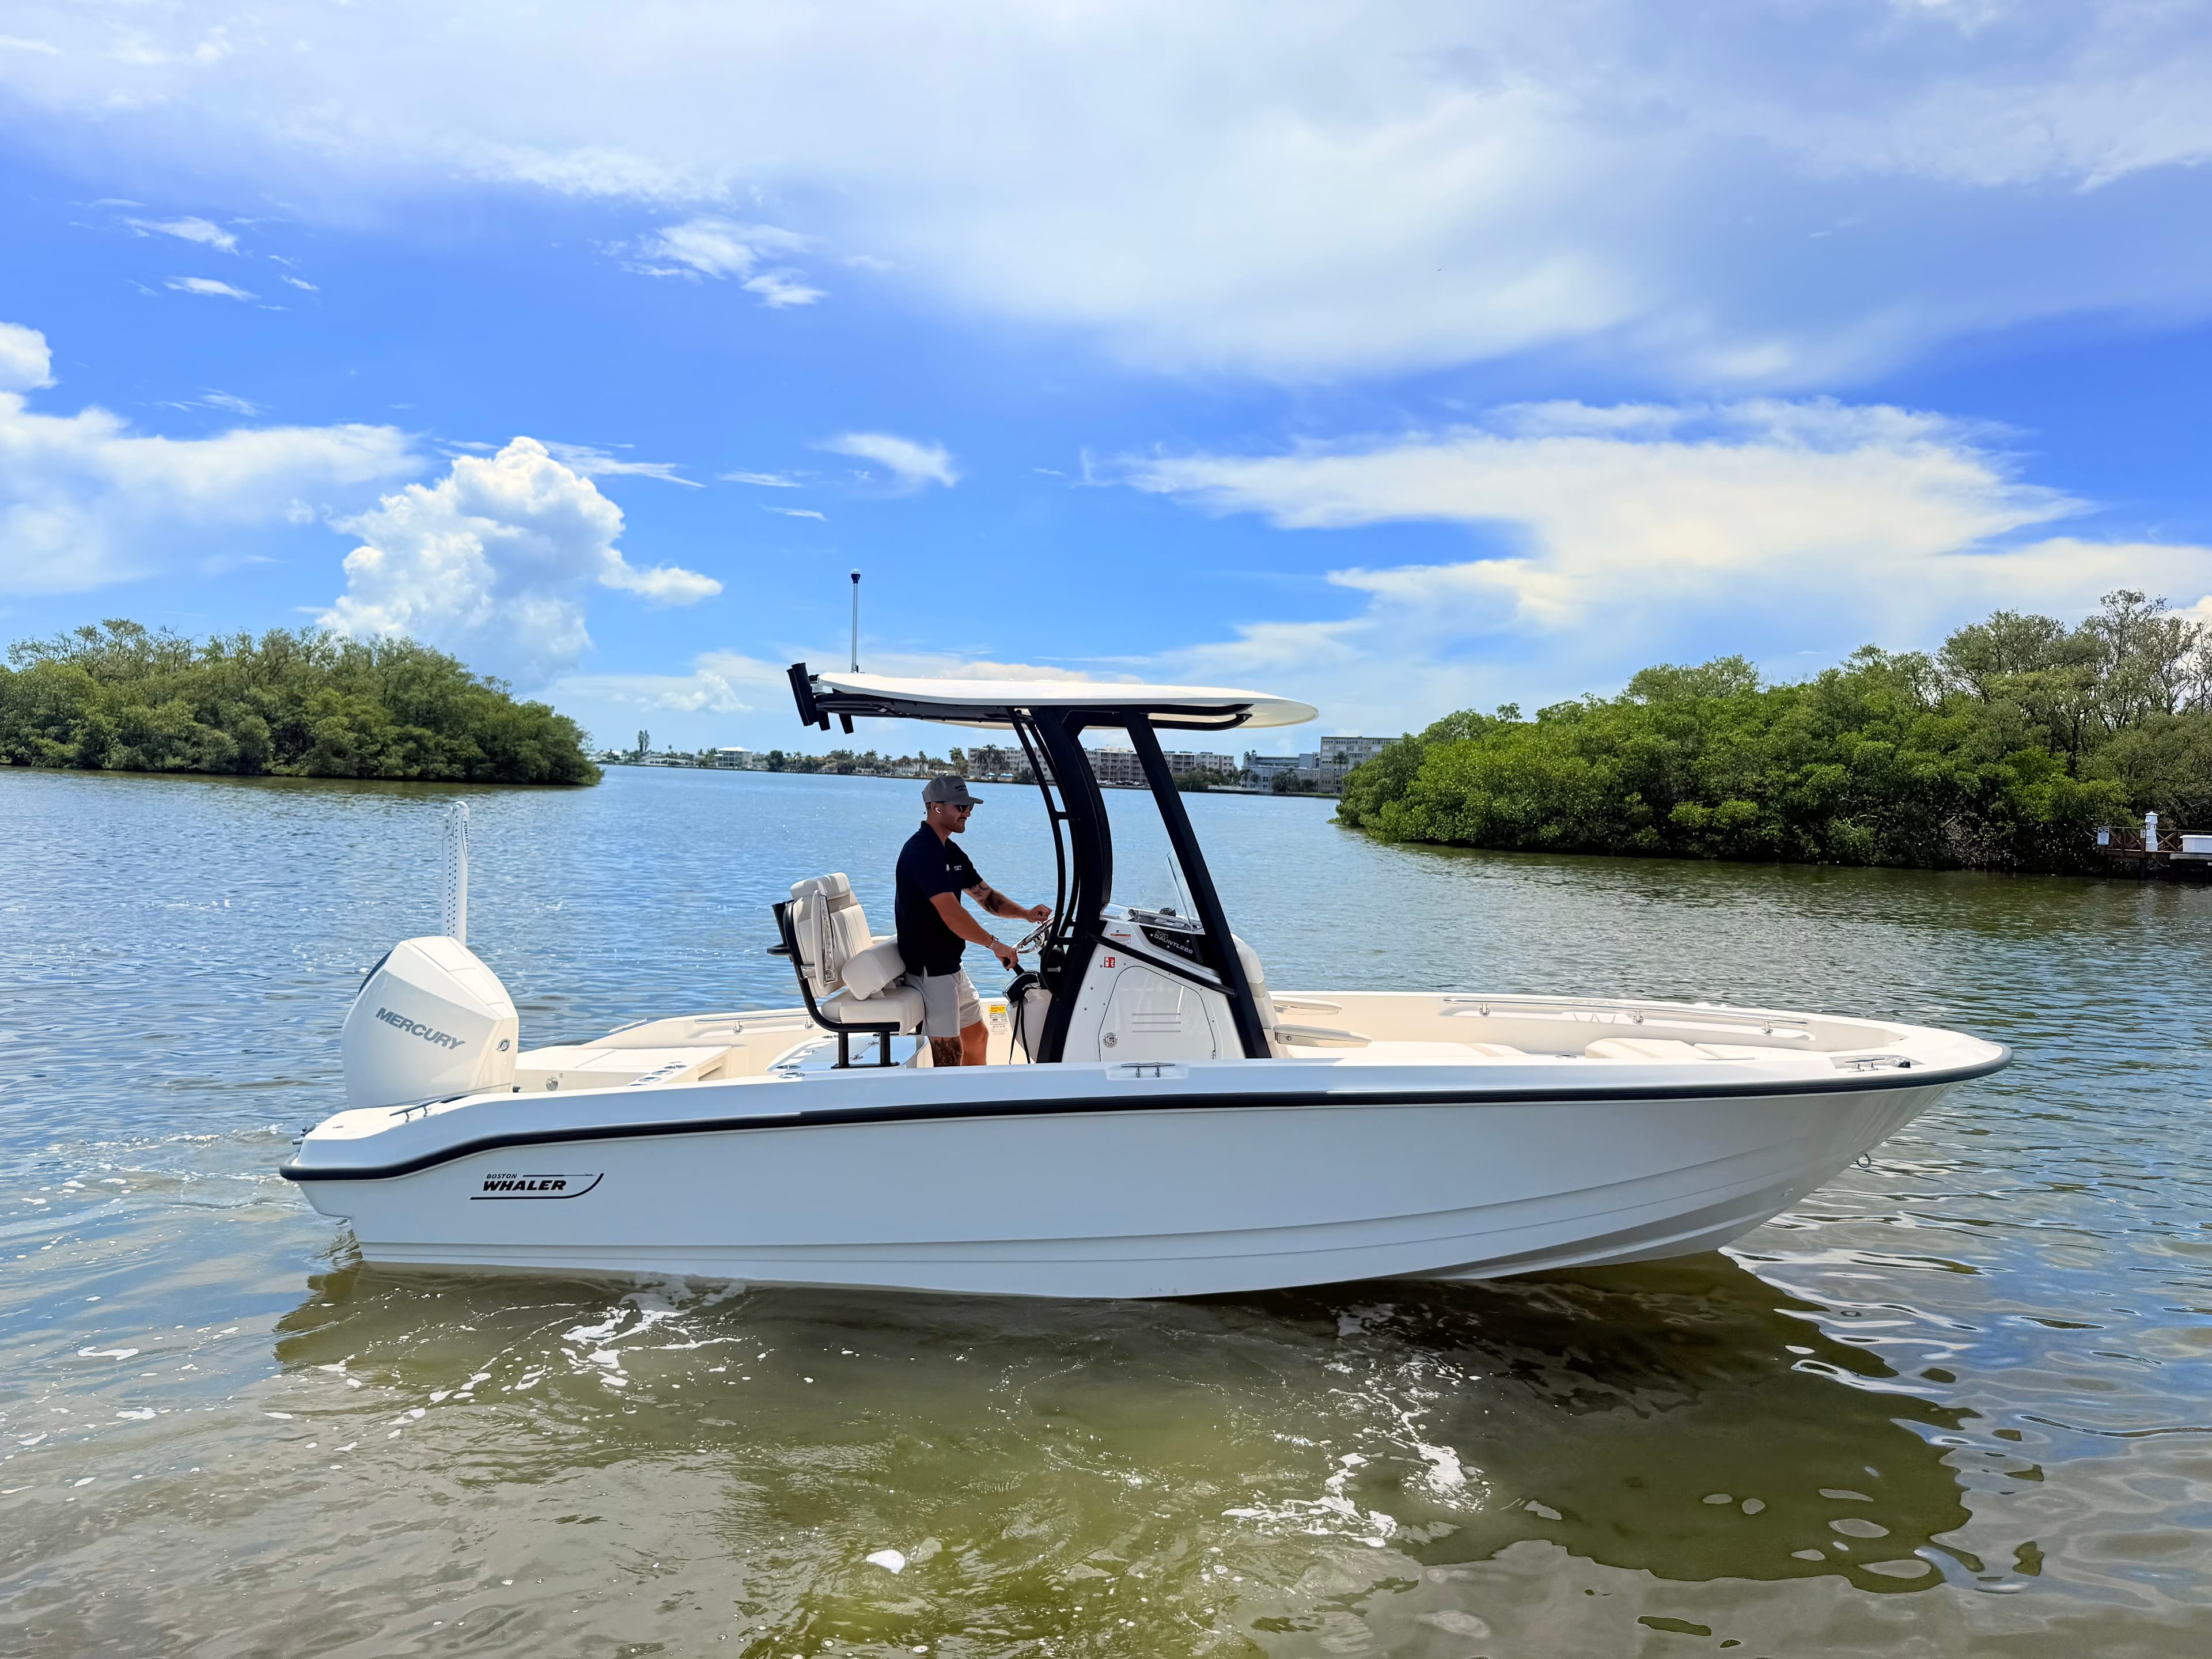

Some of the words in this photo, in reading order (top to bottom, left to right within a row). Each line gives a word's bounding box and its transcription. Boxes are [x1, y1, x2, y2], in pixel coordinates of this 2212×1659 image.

[1154, 933, 1194, 954] DAUNTLESS
[376, 1007, 466, 1050] MERCURY
[483, 1180, 566, 1191] WHALER
